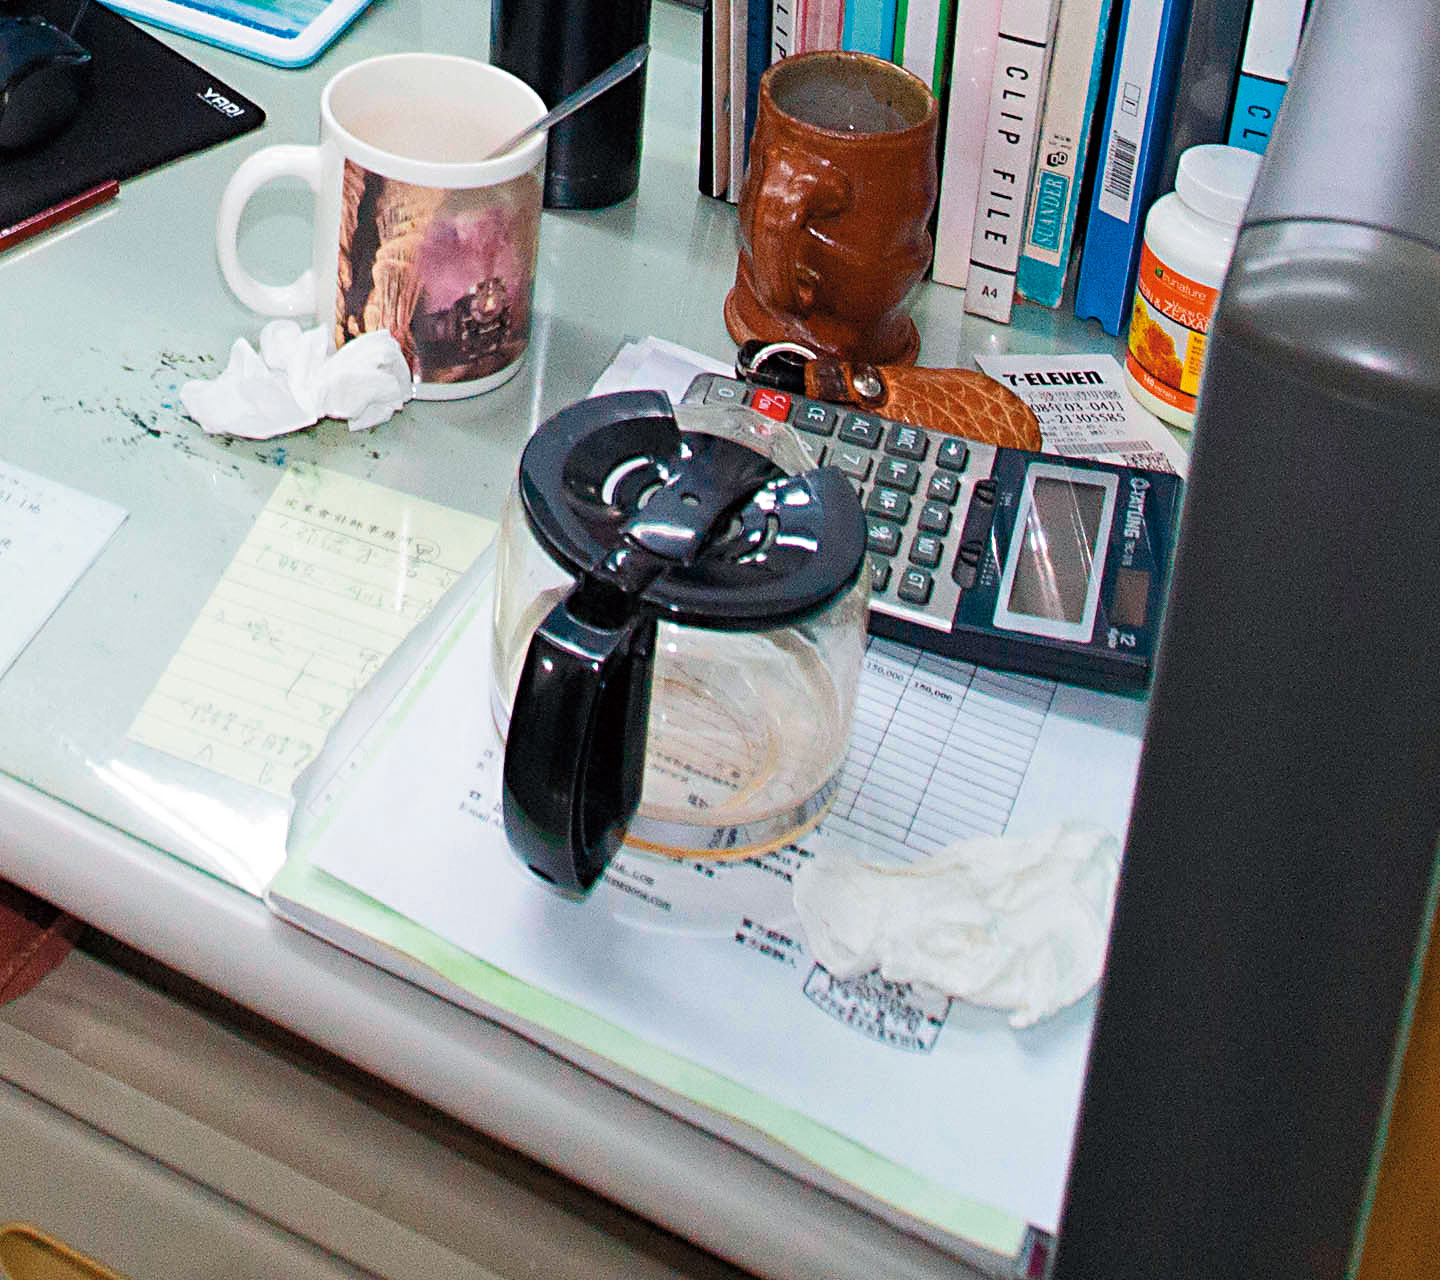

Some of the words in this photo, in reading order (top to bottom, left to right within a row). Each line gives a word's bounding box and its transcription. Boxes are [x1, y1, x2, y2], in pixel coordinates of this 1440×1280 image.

[202, 86, 246, 118] YADI
[997, 64, 1030, 147] CLIP
[983, 168, 1017, 247] FILE
[980, 283, 1000, 301] A4
[806, 406, 826, 423] CE
[851, 416, 871, 435] AC
[842, 452, 862, 466] 7
[907, 572, 925, 590] GT
[913, 680, 953, 703] 150,000
